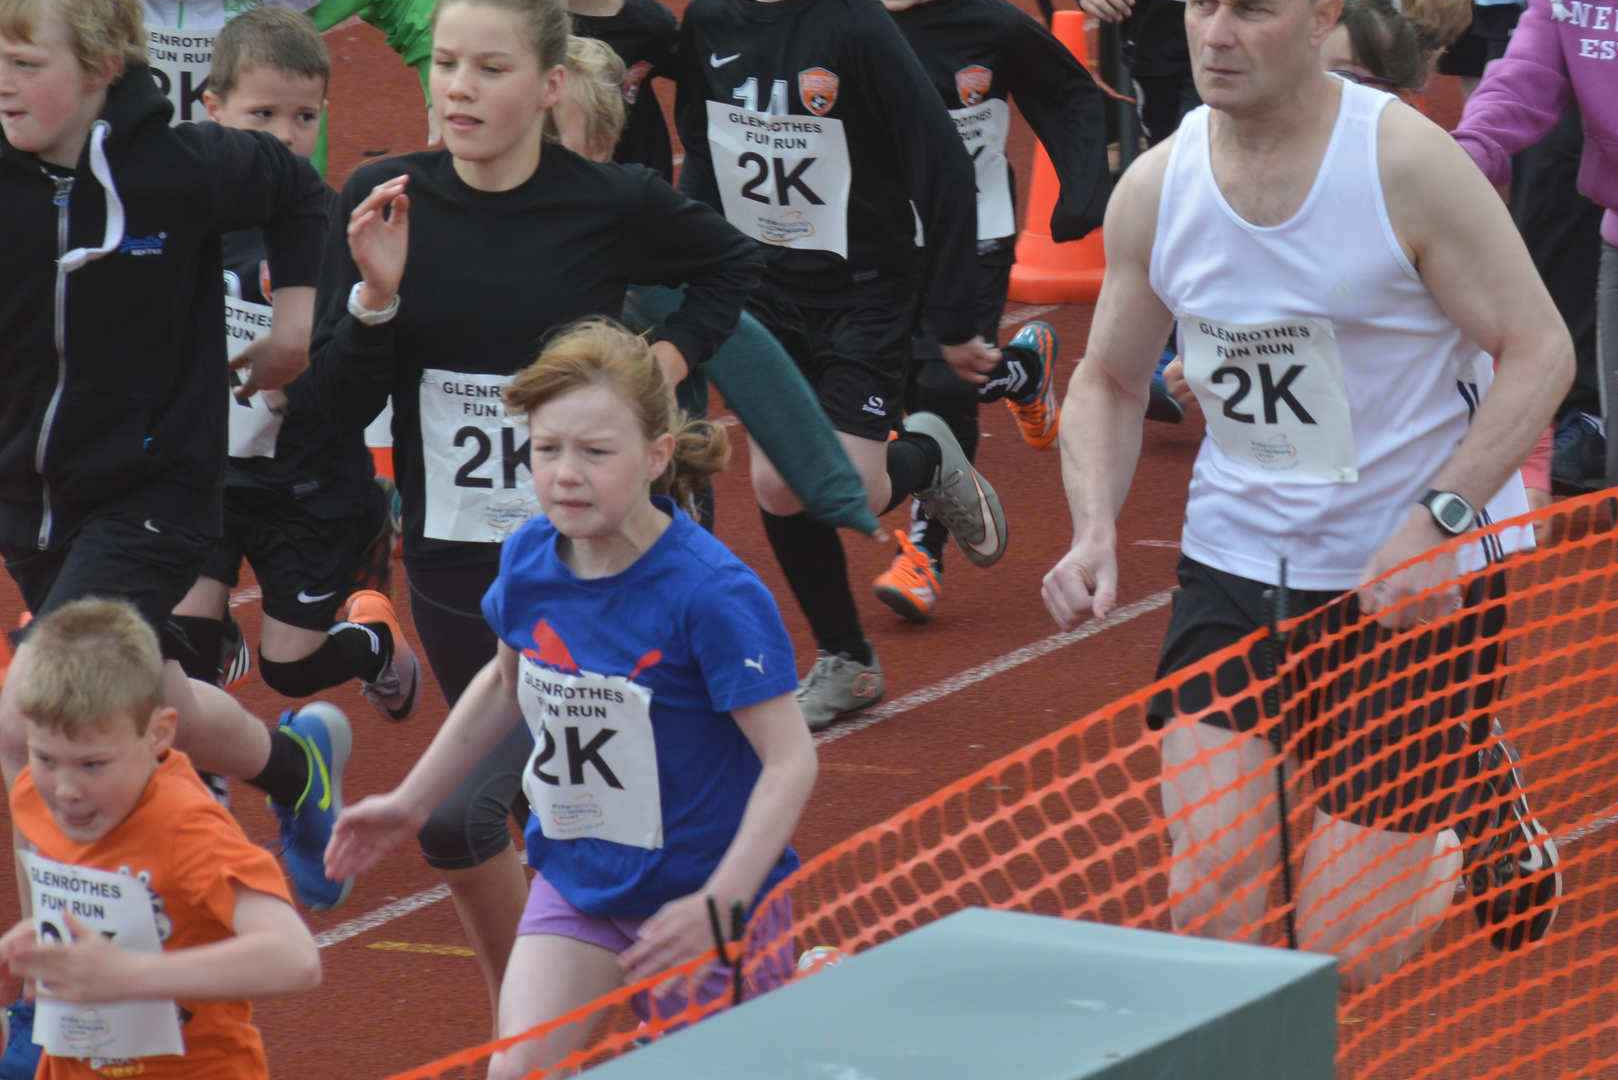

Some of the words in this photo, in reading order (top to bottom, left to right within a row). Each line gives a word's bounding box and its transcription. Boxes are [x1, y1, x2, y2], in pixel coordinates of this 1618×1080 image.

[774, 137, 808, 151] RUN
[737, 151, 827, 207] 2K
[1199, 322, 1311, 344] GLENROTHES
[1216, 344, 1251, 360] FUN
[1256, 343, 1295, 356] RUN
[1210, 362, 1319, 426] 2K
[463, 402, 498, 418] FUN
[524, 671, 625, 704] GLENROTHES
[567, 705, 608, 719] RUN
[532, 719, 626, 791] 2K
[31, 866, 122, 900] GLENROTHES
[72, 900, 106, 920] RUN
